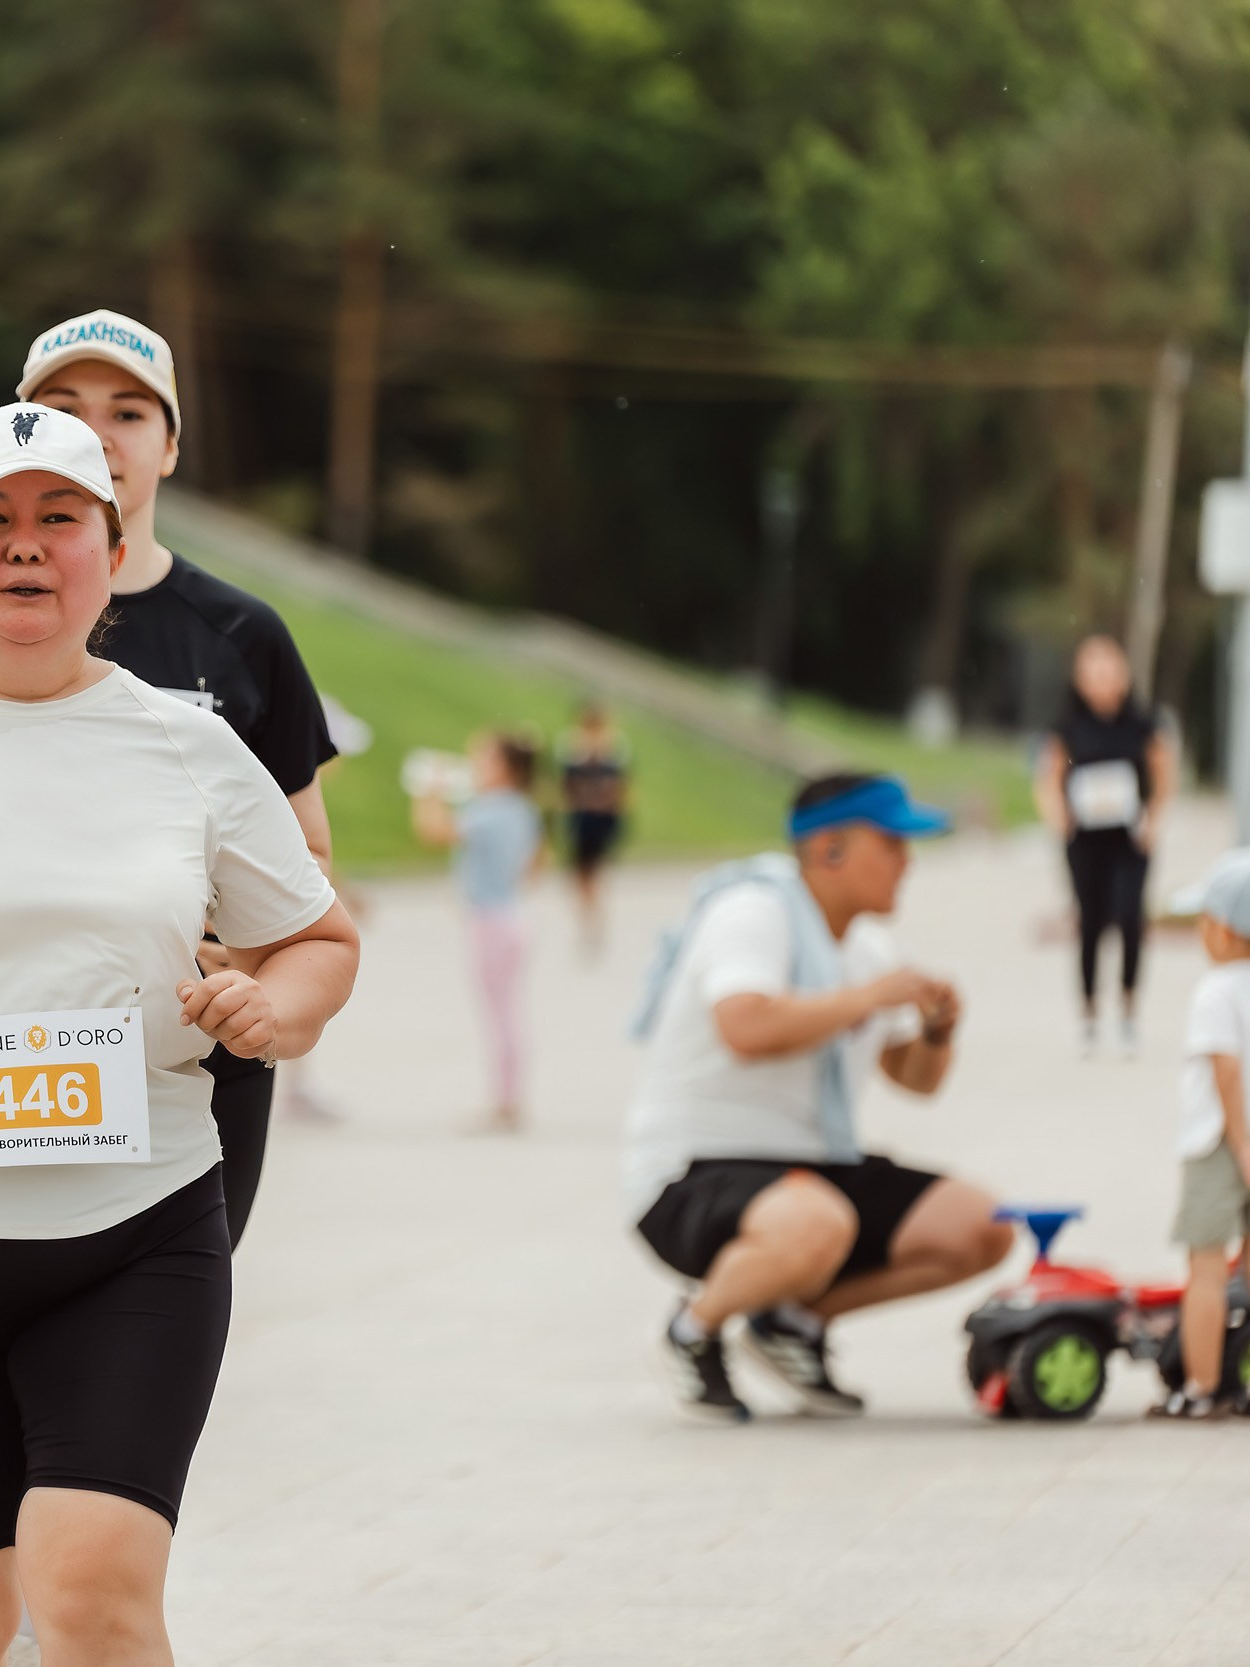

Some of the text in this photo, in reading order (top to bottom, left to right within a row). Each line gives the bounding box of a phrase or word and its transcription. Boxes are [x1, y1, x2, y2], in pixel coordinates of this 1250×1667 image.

[41, 320, 155, 362] KAZAKHSTAN
[58, 1028, 124, 1047] D'ORO
[93, 1134, 129, 1146] ЗАБЕГ
